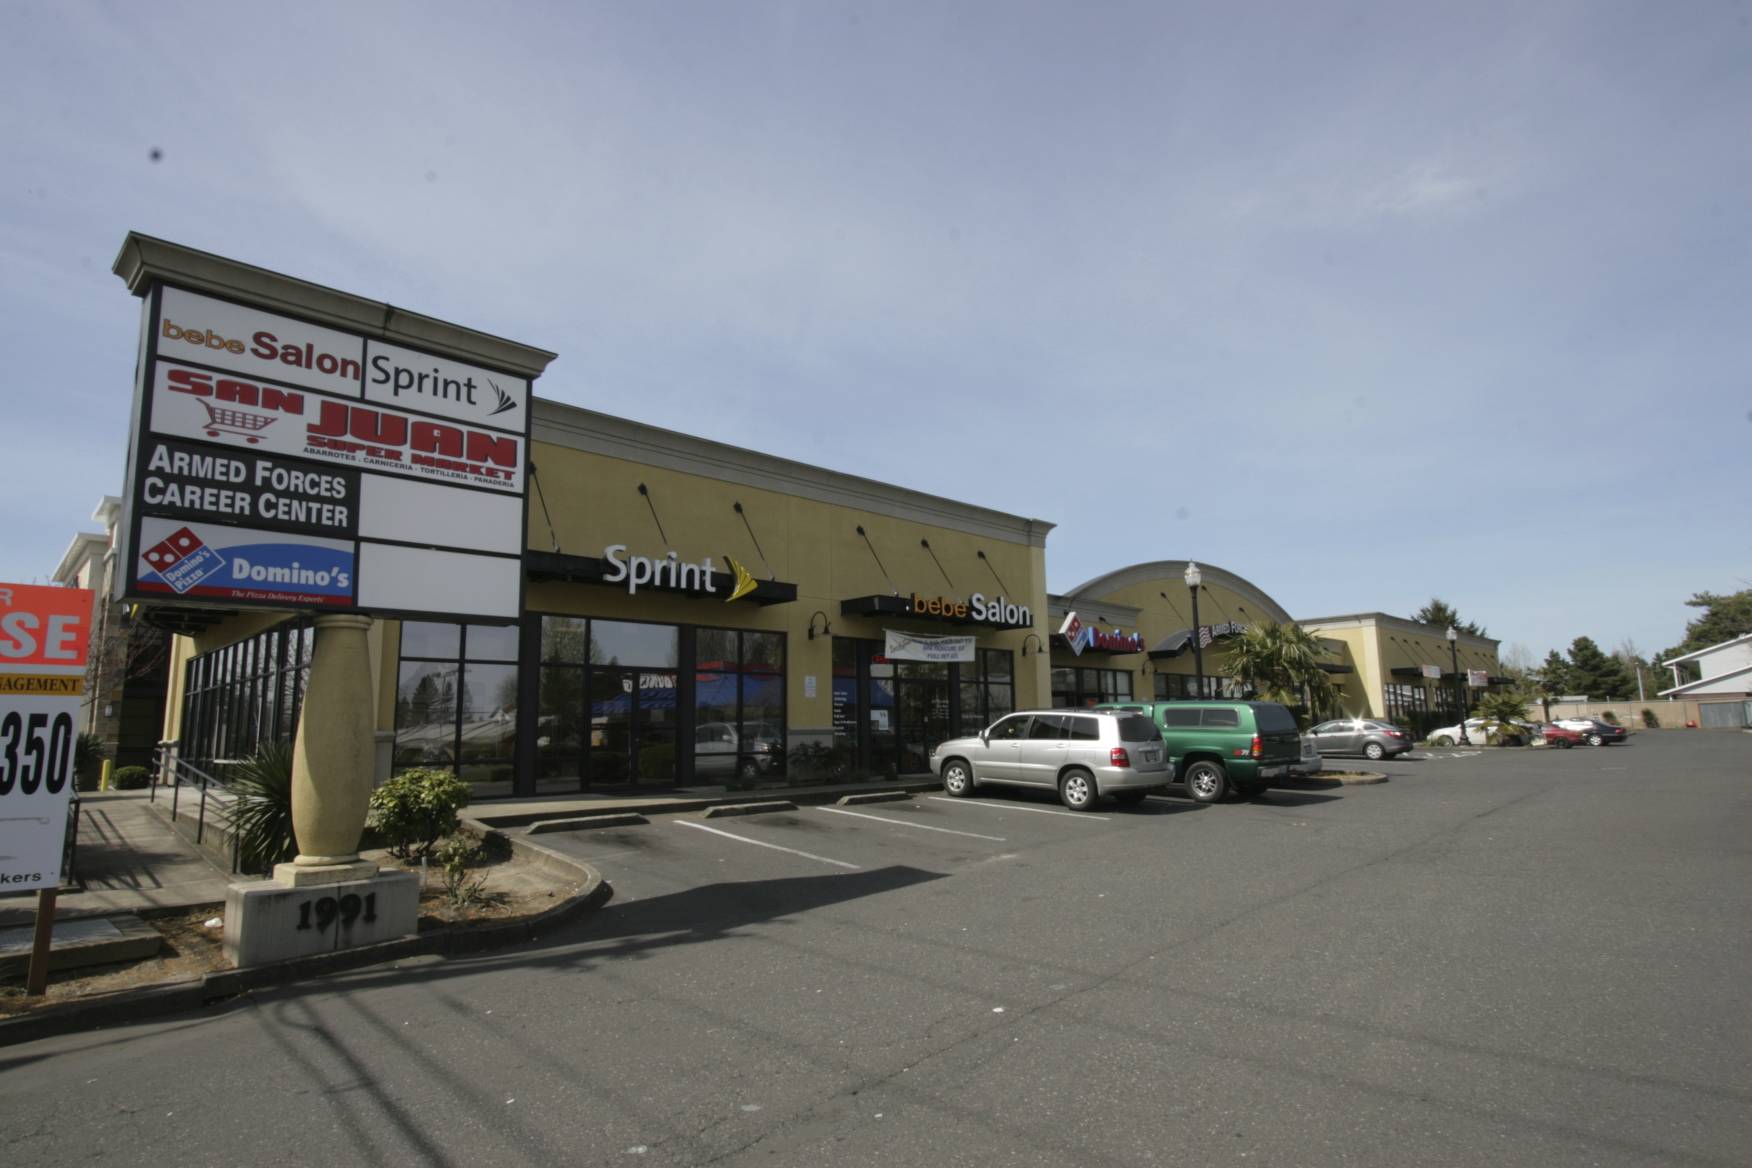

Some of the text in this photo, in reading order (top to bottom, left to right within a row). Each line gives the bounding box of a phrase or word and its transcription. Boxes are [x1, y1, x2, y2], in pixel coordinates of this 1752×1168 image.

[163, 318, 361, 381] bebe Salon
[167, 368, 304, 416] SAN
[371, 354, 477, 406] Sprint
[306, 399, 518, 470] JUAN
[306, 434, 515, 480] SUPER MARKET
[148, 444, 347, 499] ARMED FORCES
[303, 446, 356, 461] ABARROTES
[363, 457, 413, 471] CARNICERIA
[420, 466, 468, 480] TORTILLERIA
[144, 476, 348, 528] CAREER CENTER
[232, 557, 349, 589] Domino's
[603, 544, 717, 595] Sprint
[913, 592, 1031, 626] bebe Salon
[0, 675, 80, 692] AGEMENT
[296, 892, 377, 934] 1991
